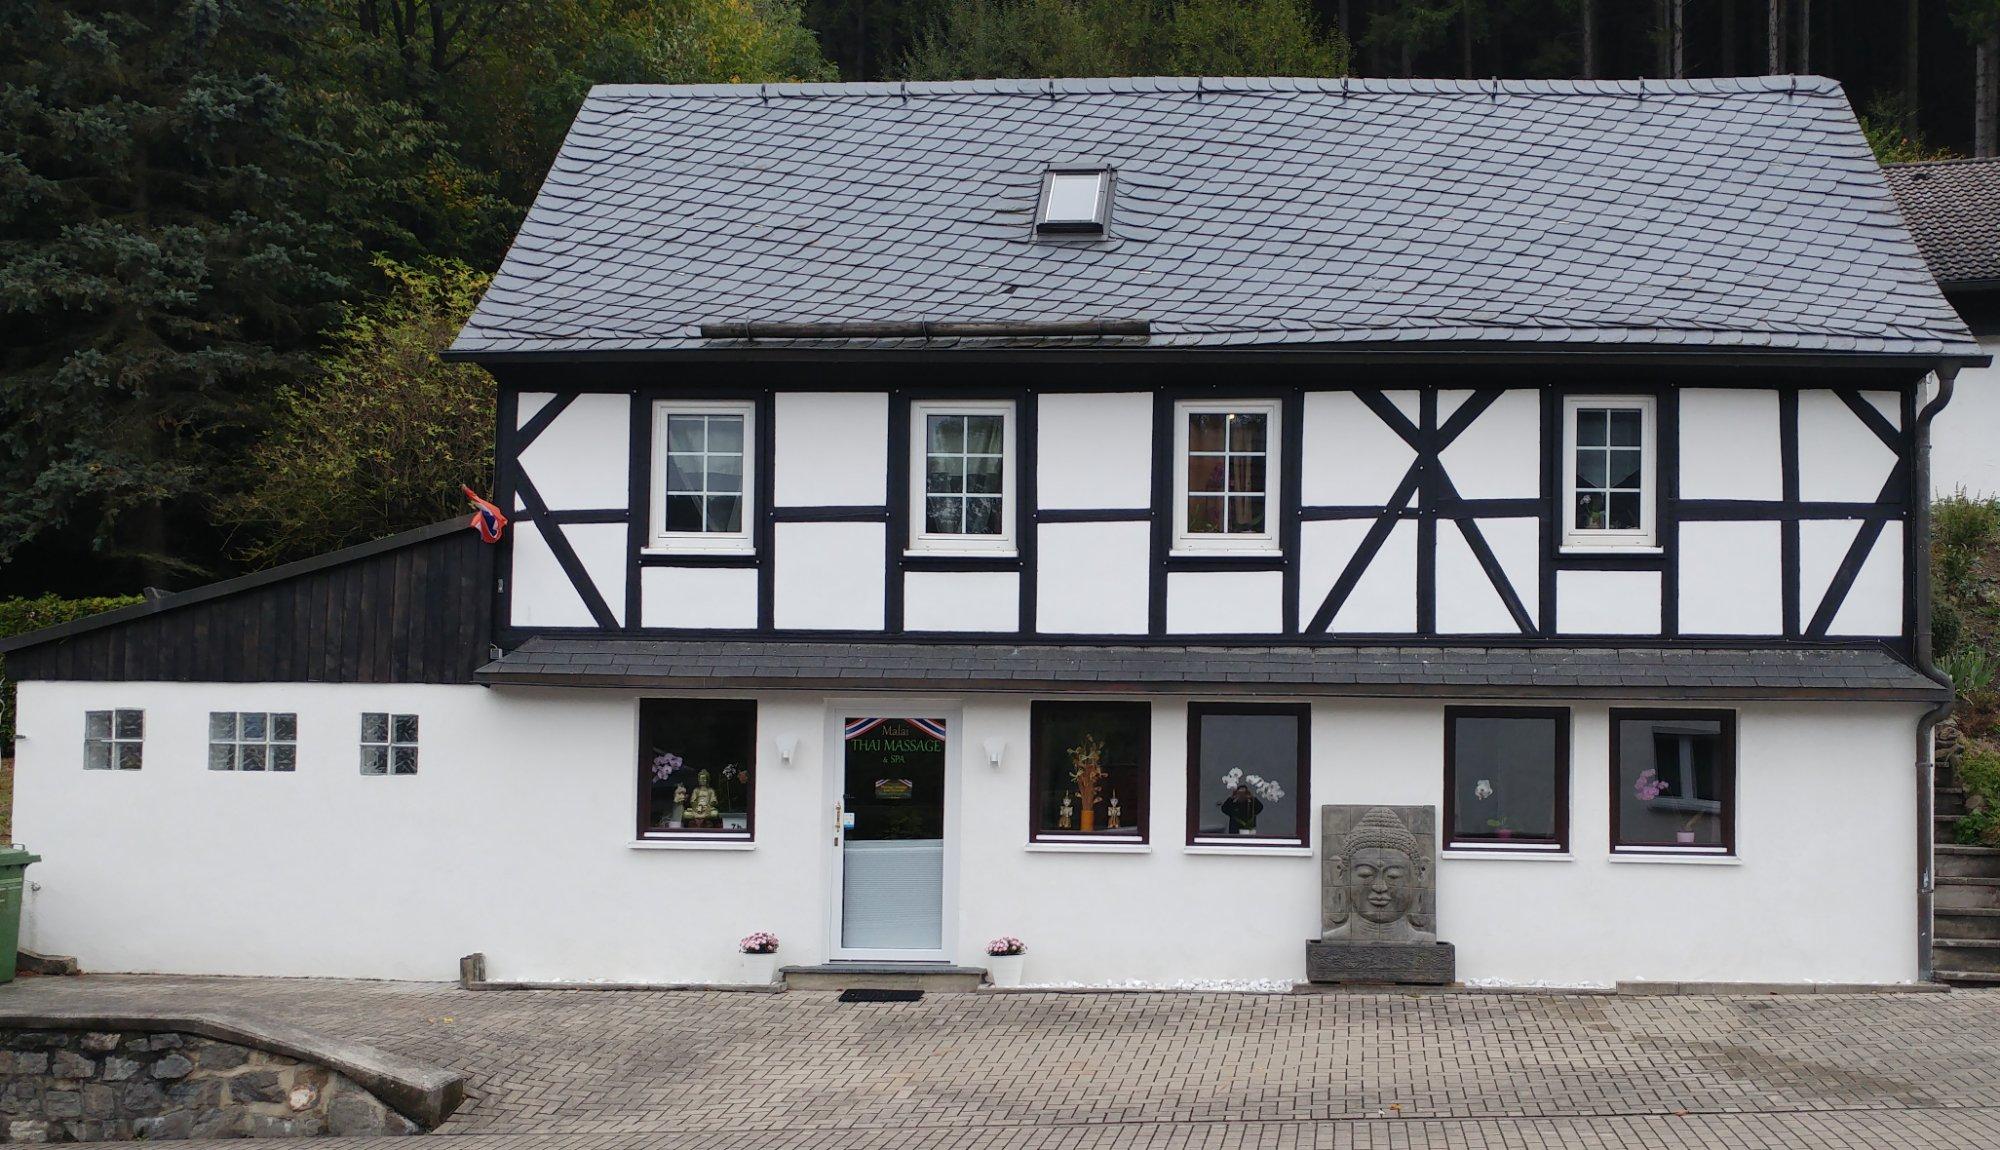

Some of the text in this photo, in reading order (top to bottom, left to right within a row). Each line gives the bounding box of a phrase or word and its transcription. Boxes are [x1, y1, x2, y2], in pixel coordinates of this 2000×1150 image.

[882, 723, 909, 736] Malai
[852, 739, 941, 752] THAI MASSAGE
[890, 755, 905, 763] SPA
